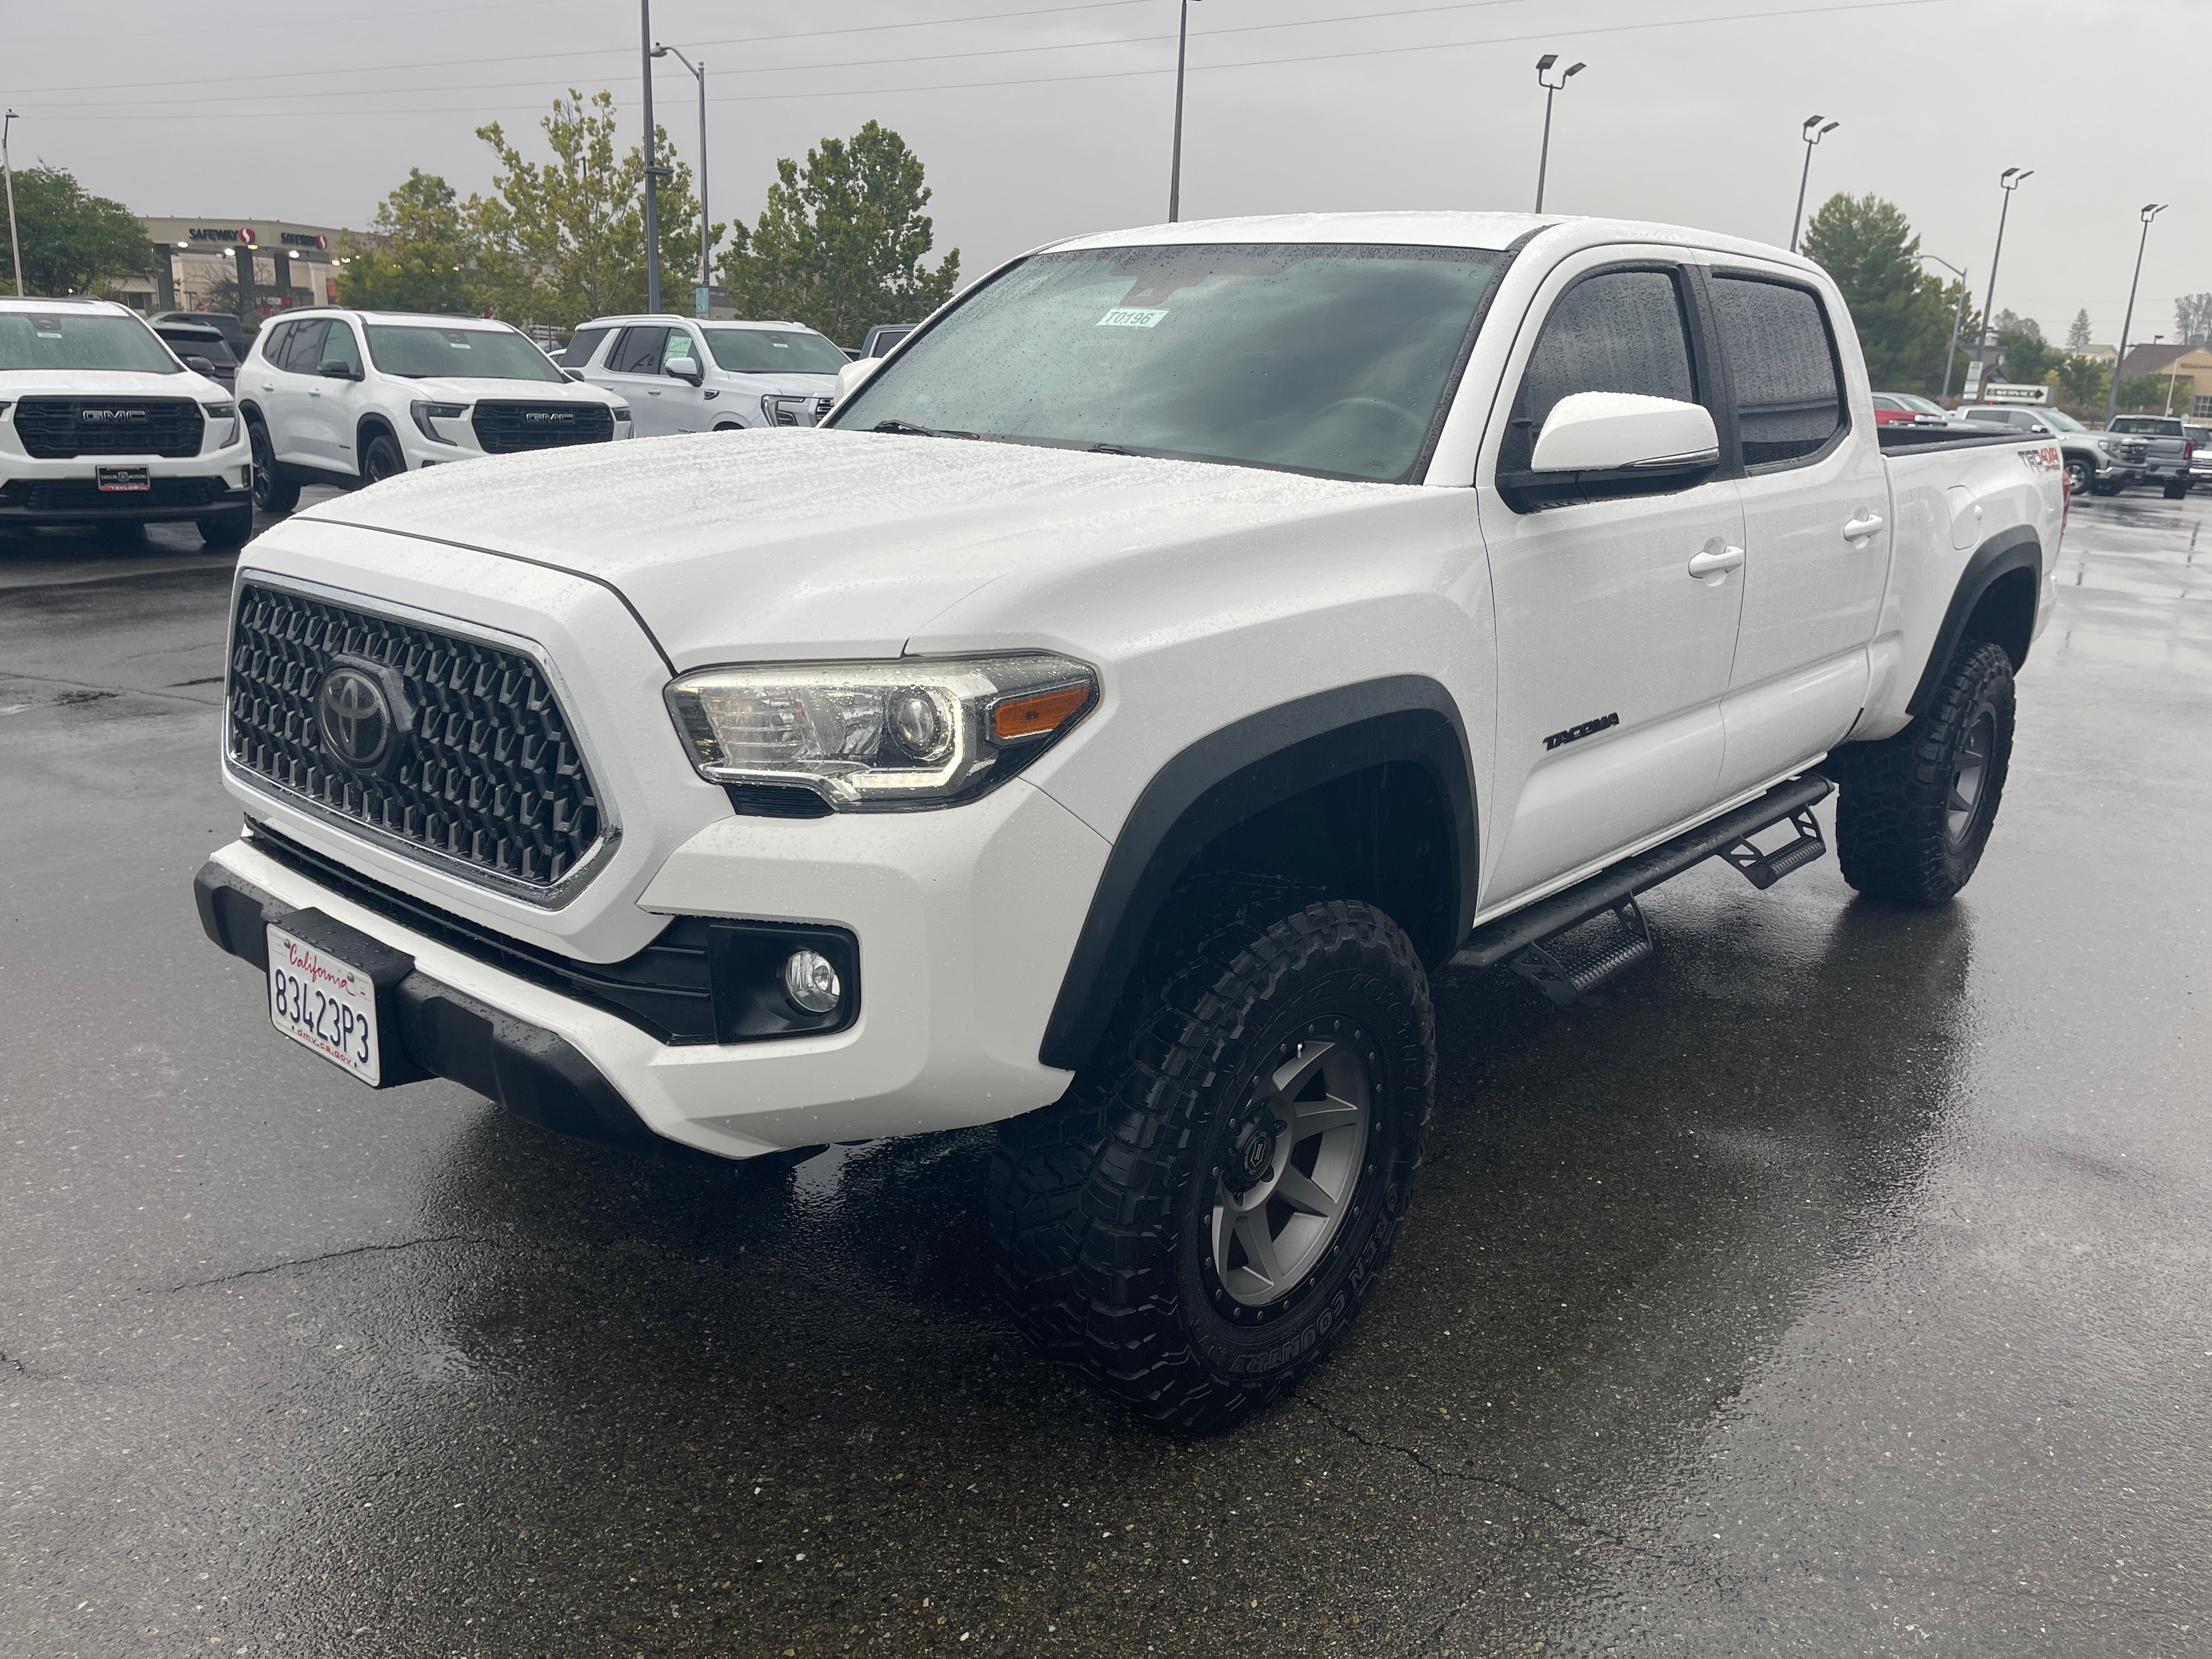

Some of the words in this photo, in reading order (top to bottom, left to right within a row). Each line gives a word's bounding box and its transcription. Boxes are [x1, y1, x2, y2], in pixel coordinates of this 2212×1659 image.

[189, 228, 239, 241] SAFEWAY
[1104, 311, 1154, 325] T0196
[83, 410, 146, 422] GMC
[526, 412, 575, 424] GMC
[1543, 712, 1620, 751] TACOMA
[290, 944, 356, 996] California
[275, 969, 369, 1064] 83423P3
[297, 1029, 352, 1064] dmv.ca.gov
[1347, 1183, 1398, 1290] OPEN
[1228, 1289, 1346, 1374] COUNTRY
